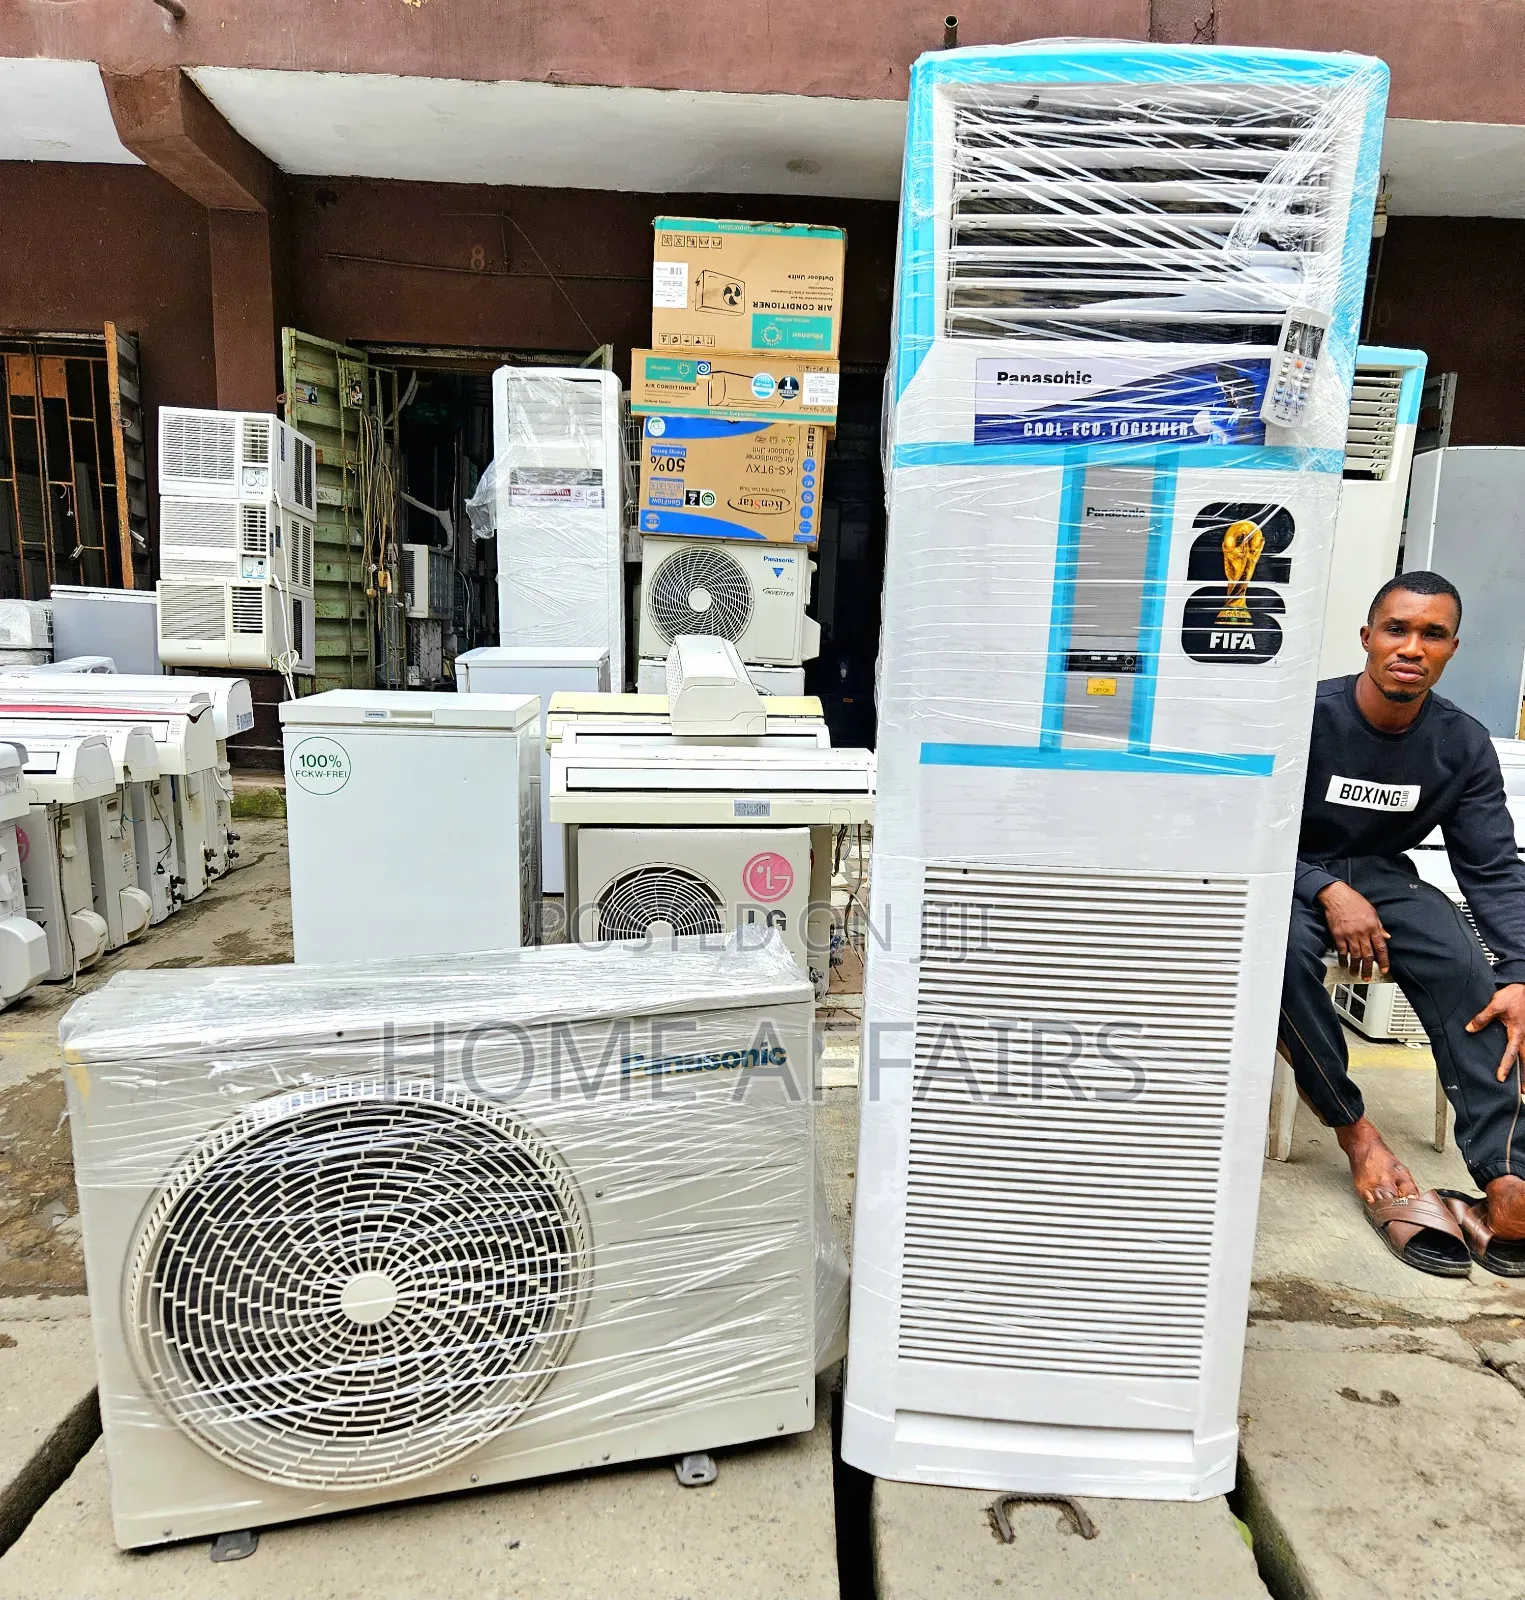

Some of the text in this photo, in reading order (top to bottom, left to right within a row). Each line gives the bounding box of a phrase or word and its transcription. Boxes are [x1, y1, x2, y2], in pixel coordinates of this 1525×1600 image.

[791, 273, 806, 281] Unit
[752, 301, 815, 311] CONDITIONER
[792, 331, 824, 341] Hisense
[785, 377, 793, 390] 1
[1023, 421, 1193, 437] COOL. ECO. TOGETHER.
[768, 448, 795, 456] Outdoor
[651, 456, 686, 472] 50%
[745, 463, 794, 476] KS-9TXV
[651, 498, 681, 506] GenFlow
[690, 498, 696, 506] 2
[738, 498, 783, 511] KenStar
[763, 555, 795, 563] Panasonic
[1209, 631, 1256, 650] FIFA
[299, 754, 342, 768] 100%
[295, 770, 348, 778] FCKW-FREI
[1339, 783, 1402, 807] BOXING
[621, 1041, 787, 1079] Panasonic
